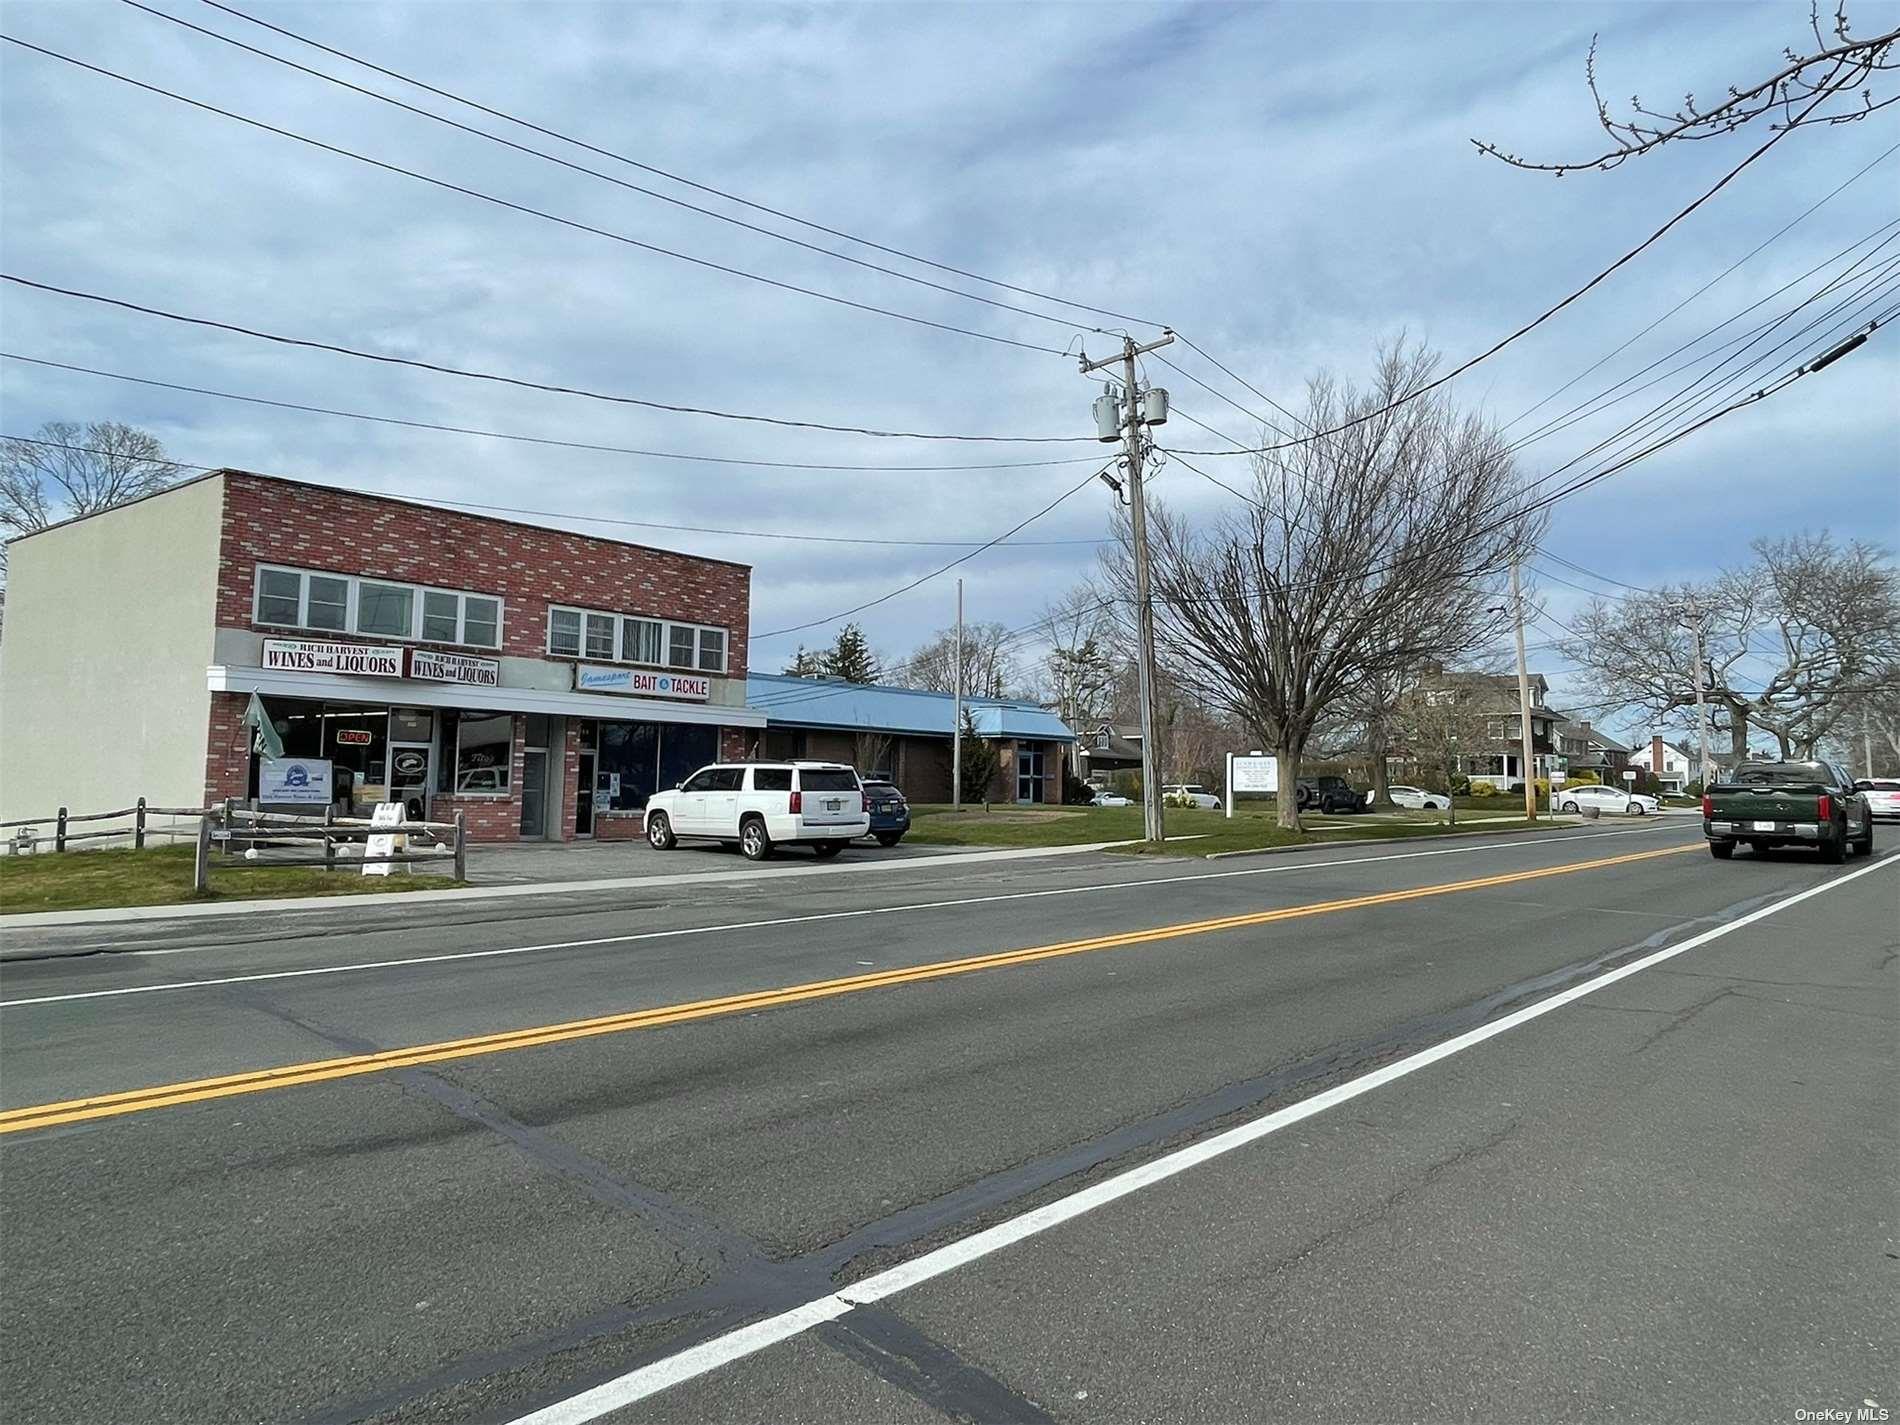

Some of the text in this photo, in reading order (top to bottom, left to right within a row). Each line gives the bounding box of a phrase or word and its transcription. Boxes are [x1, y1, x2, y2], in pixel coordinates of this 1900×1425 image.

[299, 643, 370, 656] RICH HARVEST
[268, 650, 397, 674] WINES and LIQUORS
[413, 660, 496, 685] WINES and LIQUORS
[633, 674, 658, 690] BAIT
[670, 678, 708, 695] TACKLE
[340, 732, 369, 742] OPEN
